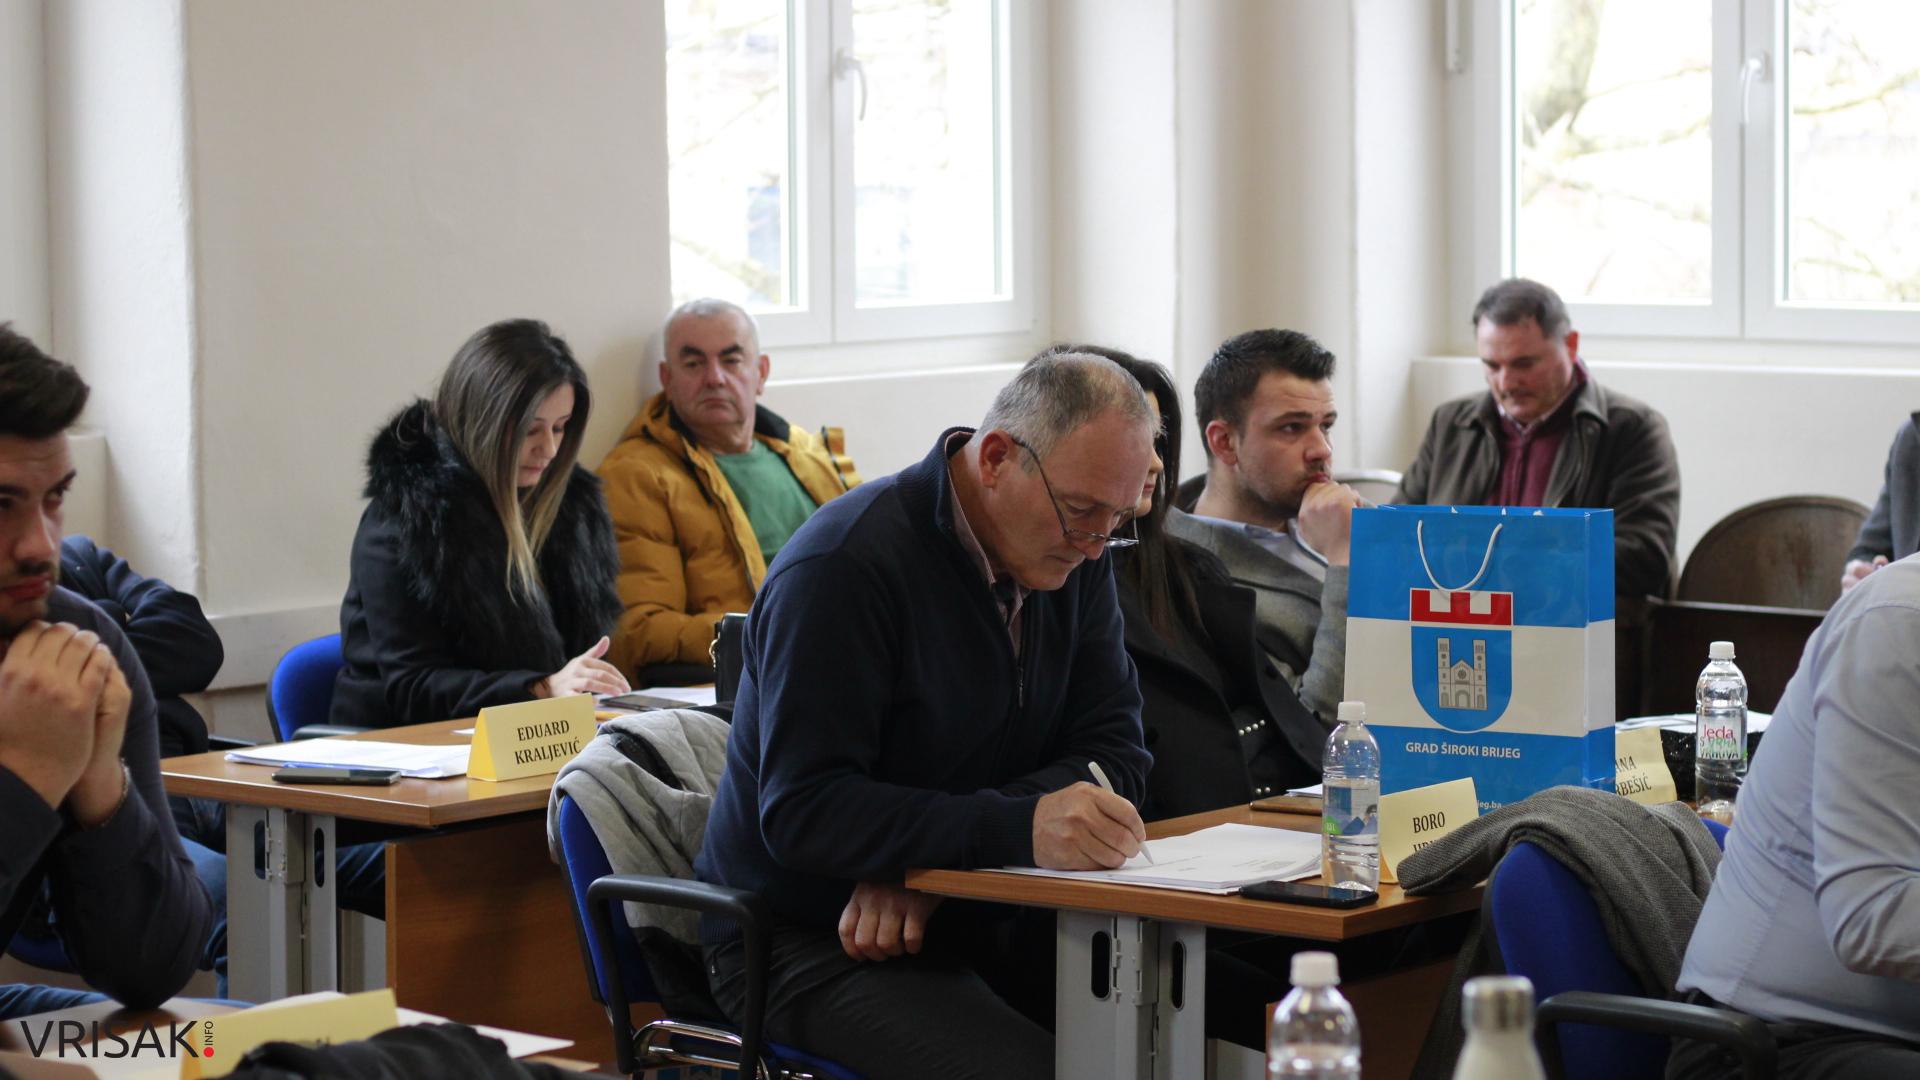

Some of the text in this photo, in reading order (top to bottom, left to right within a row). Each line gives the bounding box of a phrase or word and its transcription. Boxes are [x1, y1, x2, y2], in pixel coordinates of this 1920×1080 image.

[516, 720, 570, 741] EDUARD
[515, 736, 581, 764] KRALJEVIĆ
[1405, 742, 1520, 758] GRAD ŠIROKI BRIJEG
[1615, 755, 1637, 772] ANA
[1616, 772, 1652, 796] RBEŠIĆ
[1412, 811, 1446, 834] BORO
